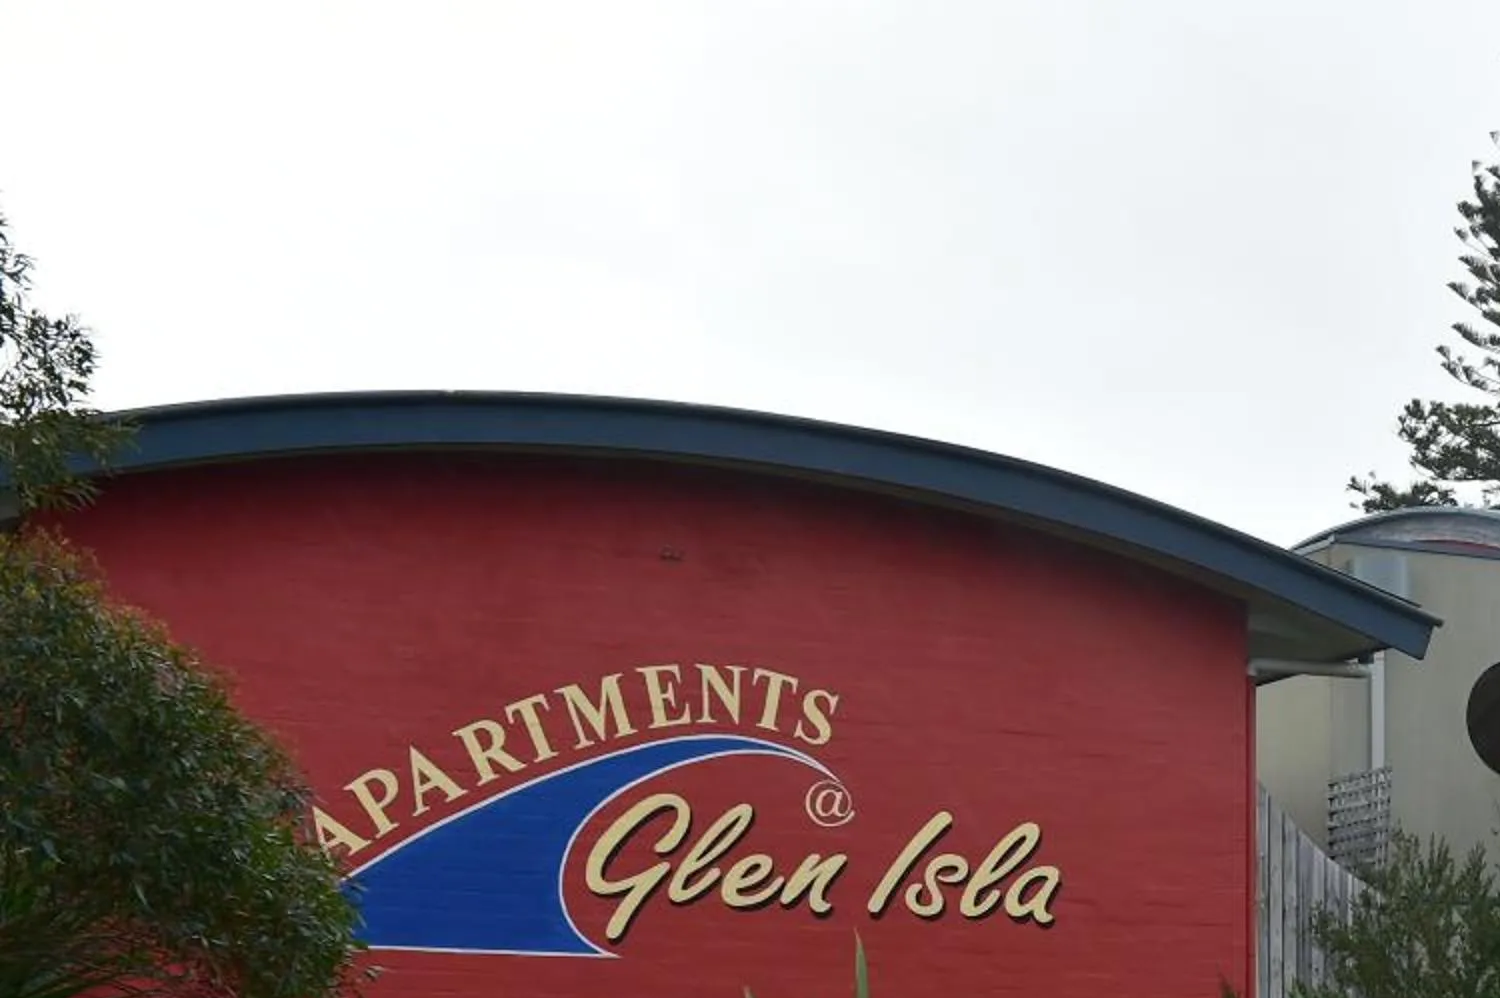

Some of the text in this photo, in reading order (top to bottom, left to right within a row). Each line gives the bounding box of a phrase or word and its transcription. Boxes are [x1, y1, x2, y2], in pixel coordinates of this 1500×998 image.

[312, 663, 840, 862] APARTMENTS
[805, 780, 855, 827] @
[585, 792, 1063, 943] Glen Isla
